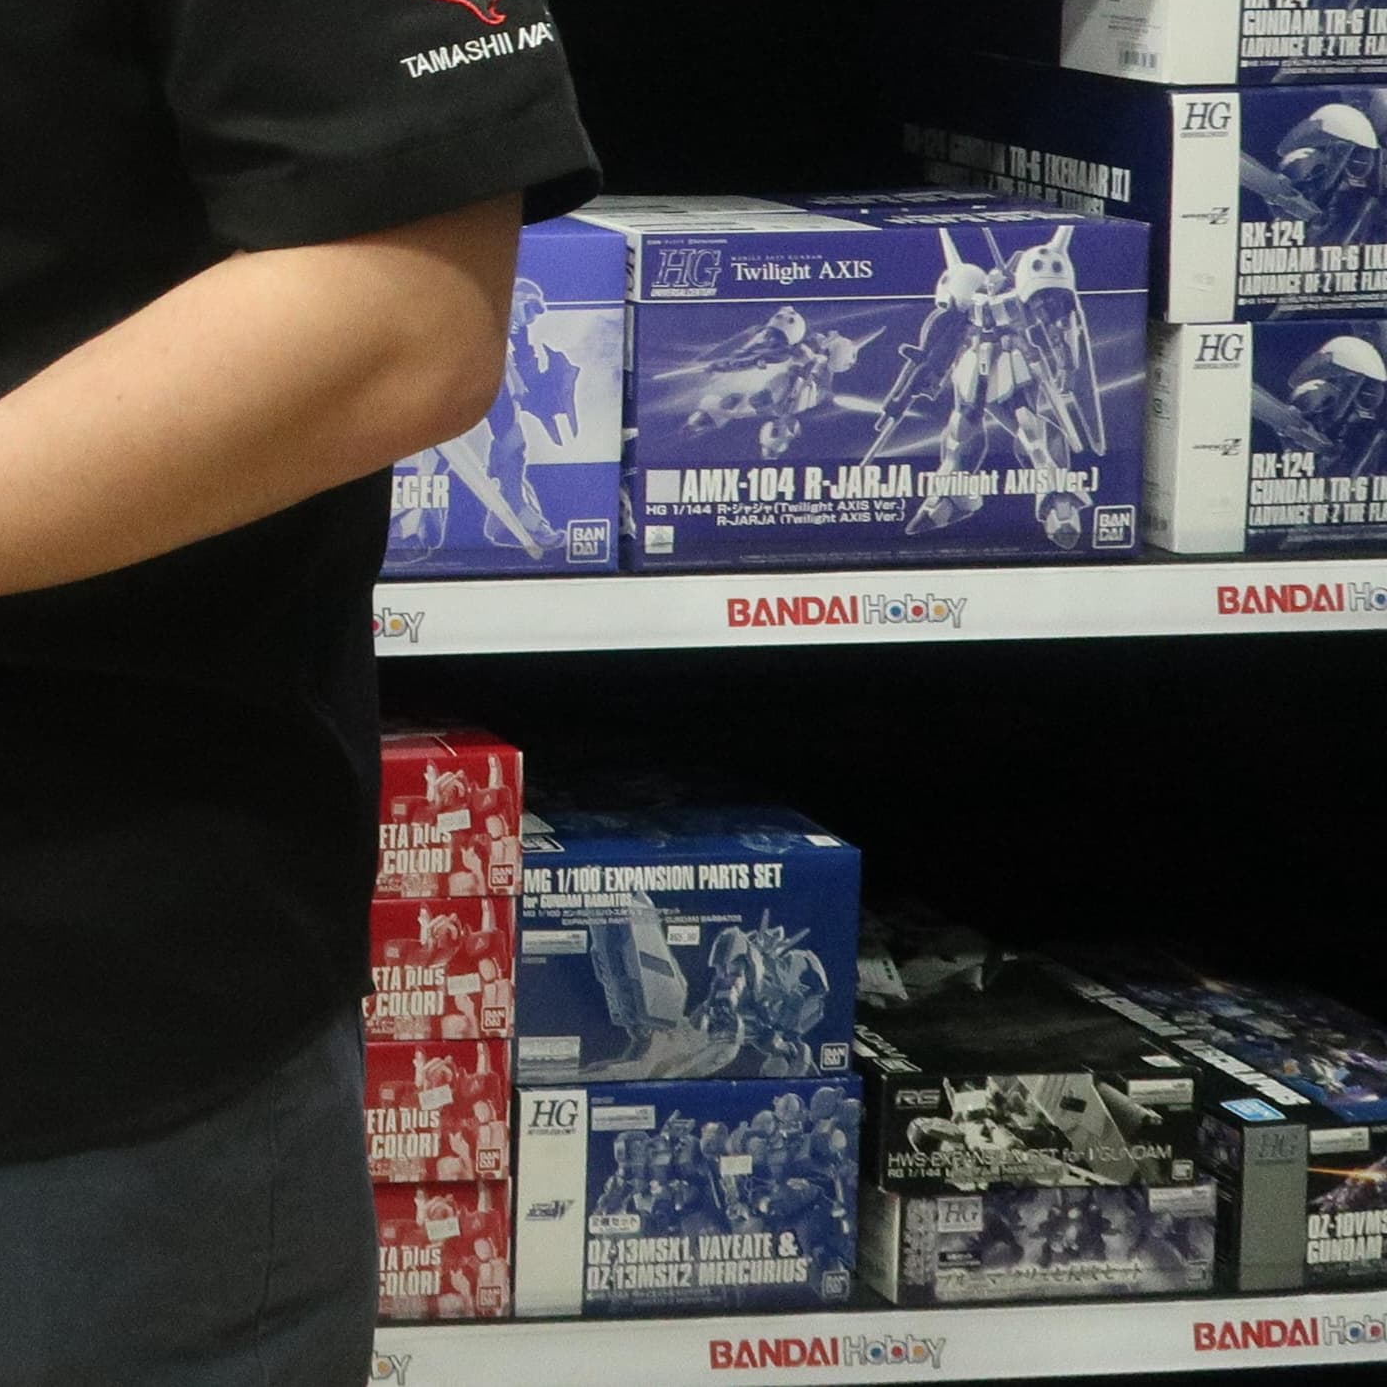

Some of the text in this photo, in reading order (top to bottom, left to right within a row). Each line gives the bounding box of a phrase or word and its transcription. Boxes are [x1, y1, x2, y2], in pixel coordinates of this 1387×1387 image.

[1242, 8, 1364, 36] GUNDAM TR-6
[400, 31, 514, 78] TAMASHII
[1182, 102, 1231, 131] HG
[1240, 220, 1306, 247] RX-124
[651, 248, 722, 288] HG
[731, 259, 873, 285] Twilight AXIS
[1239, 247, 1317, 274] GUNDAM
[1195, 333, 1244, 362] HG
[1251, 452, 1316, 478] RX-124
[392, 475, 450, 510] EGER
[681, 466, 795, 503] AMX-104
[804, 464, 913, 501] R-JARJA
[1004, 469, 1049, 494] AXIS
[646, 503, 712, 516] HG 1/144
[716, 515, 776, 527] R-JARJA
[838, 511, 871, 523] AXIS
[1099, 513, 1131, 528] BAN
[572, 527, 605, 542] BAN
[1099, 527, 1125, 542] DAI
[572, 542, 598, 556] DAI
[728, 593, 967, 630] BANDAI Hobby
[1217, 583, 1344, 615] BANDAI
[524, 864, 783, 893] MG 1/100 EXPANSION PARTS SET
[532, 1099, 578, 1128] HG
[698, 1233, 773, 1260] VAYEATE
[779, 1232, 798, 1257] &
[1306, 1237, 1383, 1264] GUNDAM
[698, 1258, 807, 1287] MERCURIUS
[1194, 1318, 1319, 1351] BANDAI
[710, 1335, 946, 1369] BANDAI Hobby
